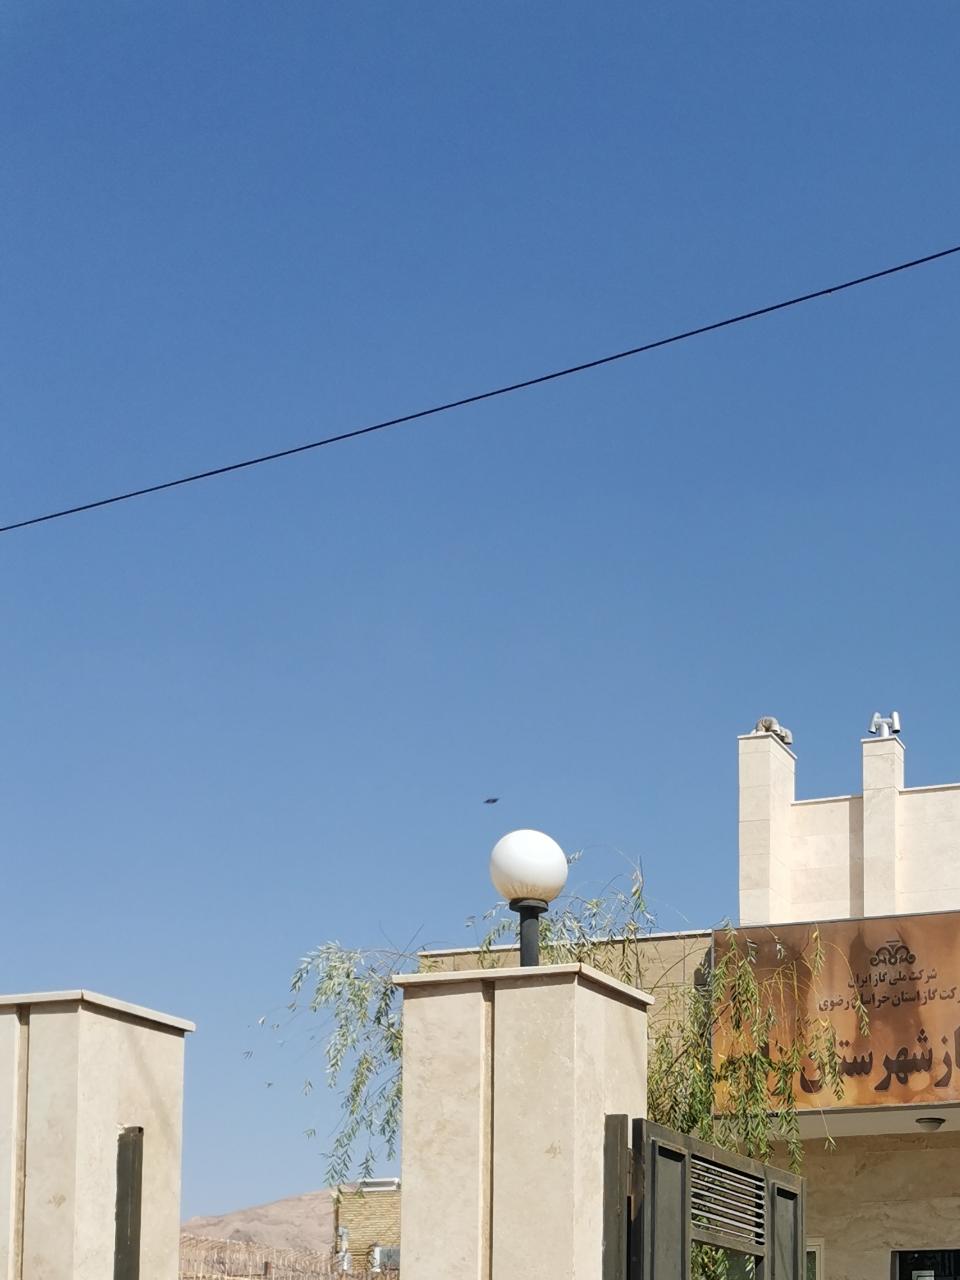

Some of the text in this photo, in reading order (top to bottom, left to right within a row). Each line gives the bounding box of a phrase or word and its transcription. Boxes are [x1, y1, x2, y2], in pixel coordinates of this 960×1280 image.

[874, 970, 888, 987] گاز
[889, 971, 907, 986] ملی
[910, 968, 938, 984] شرکت
[819, 994, 849, 1011] رضوی
[891, 989, 920, 1007] استان
[920, 987, 938, 1005] گاز
